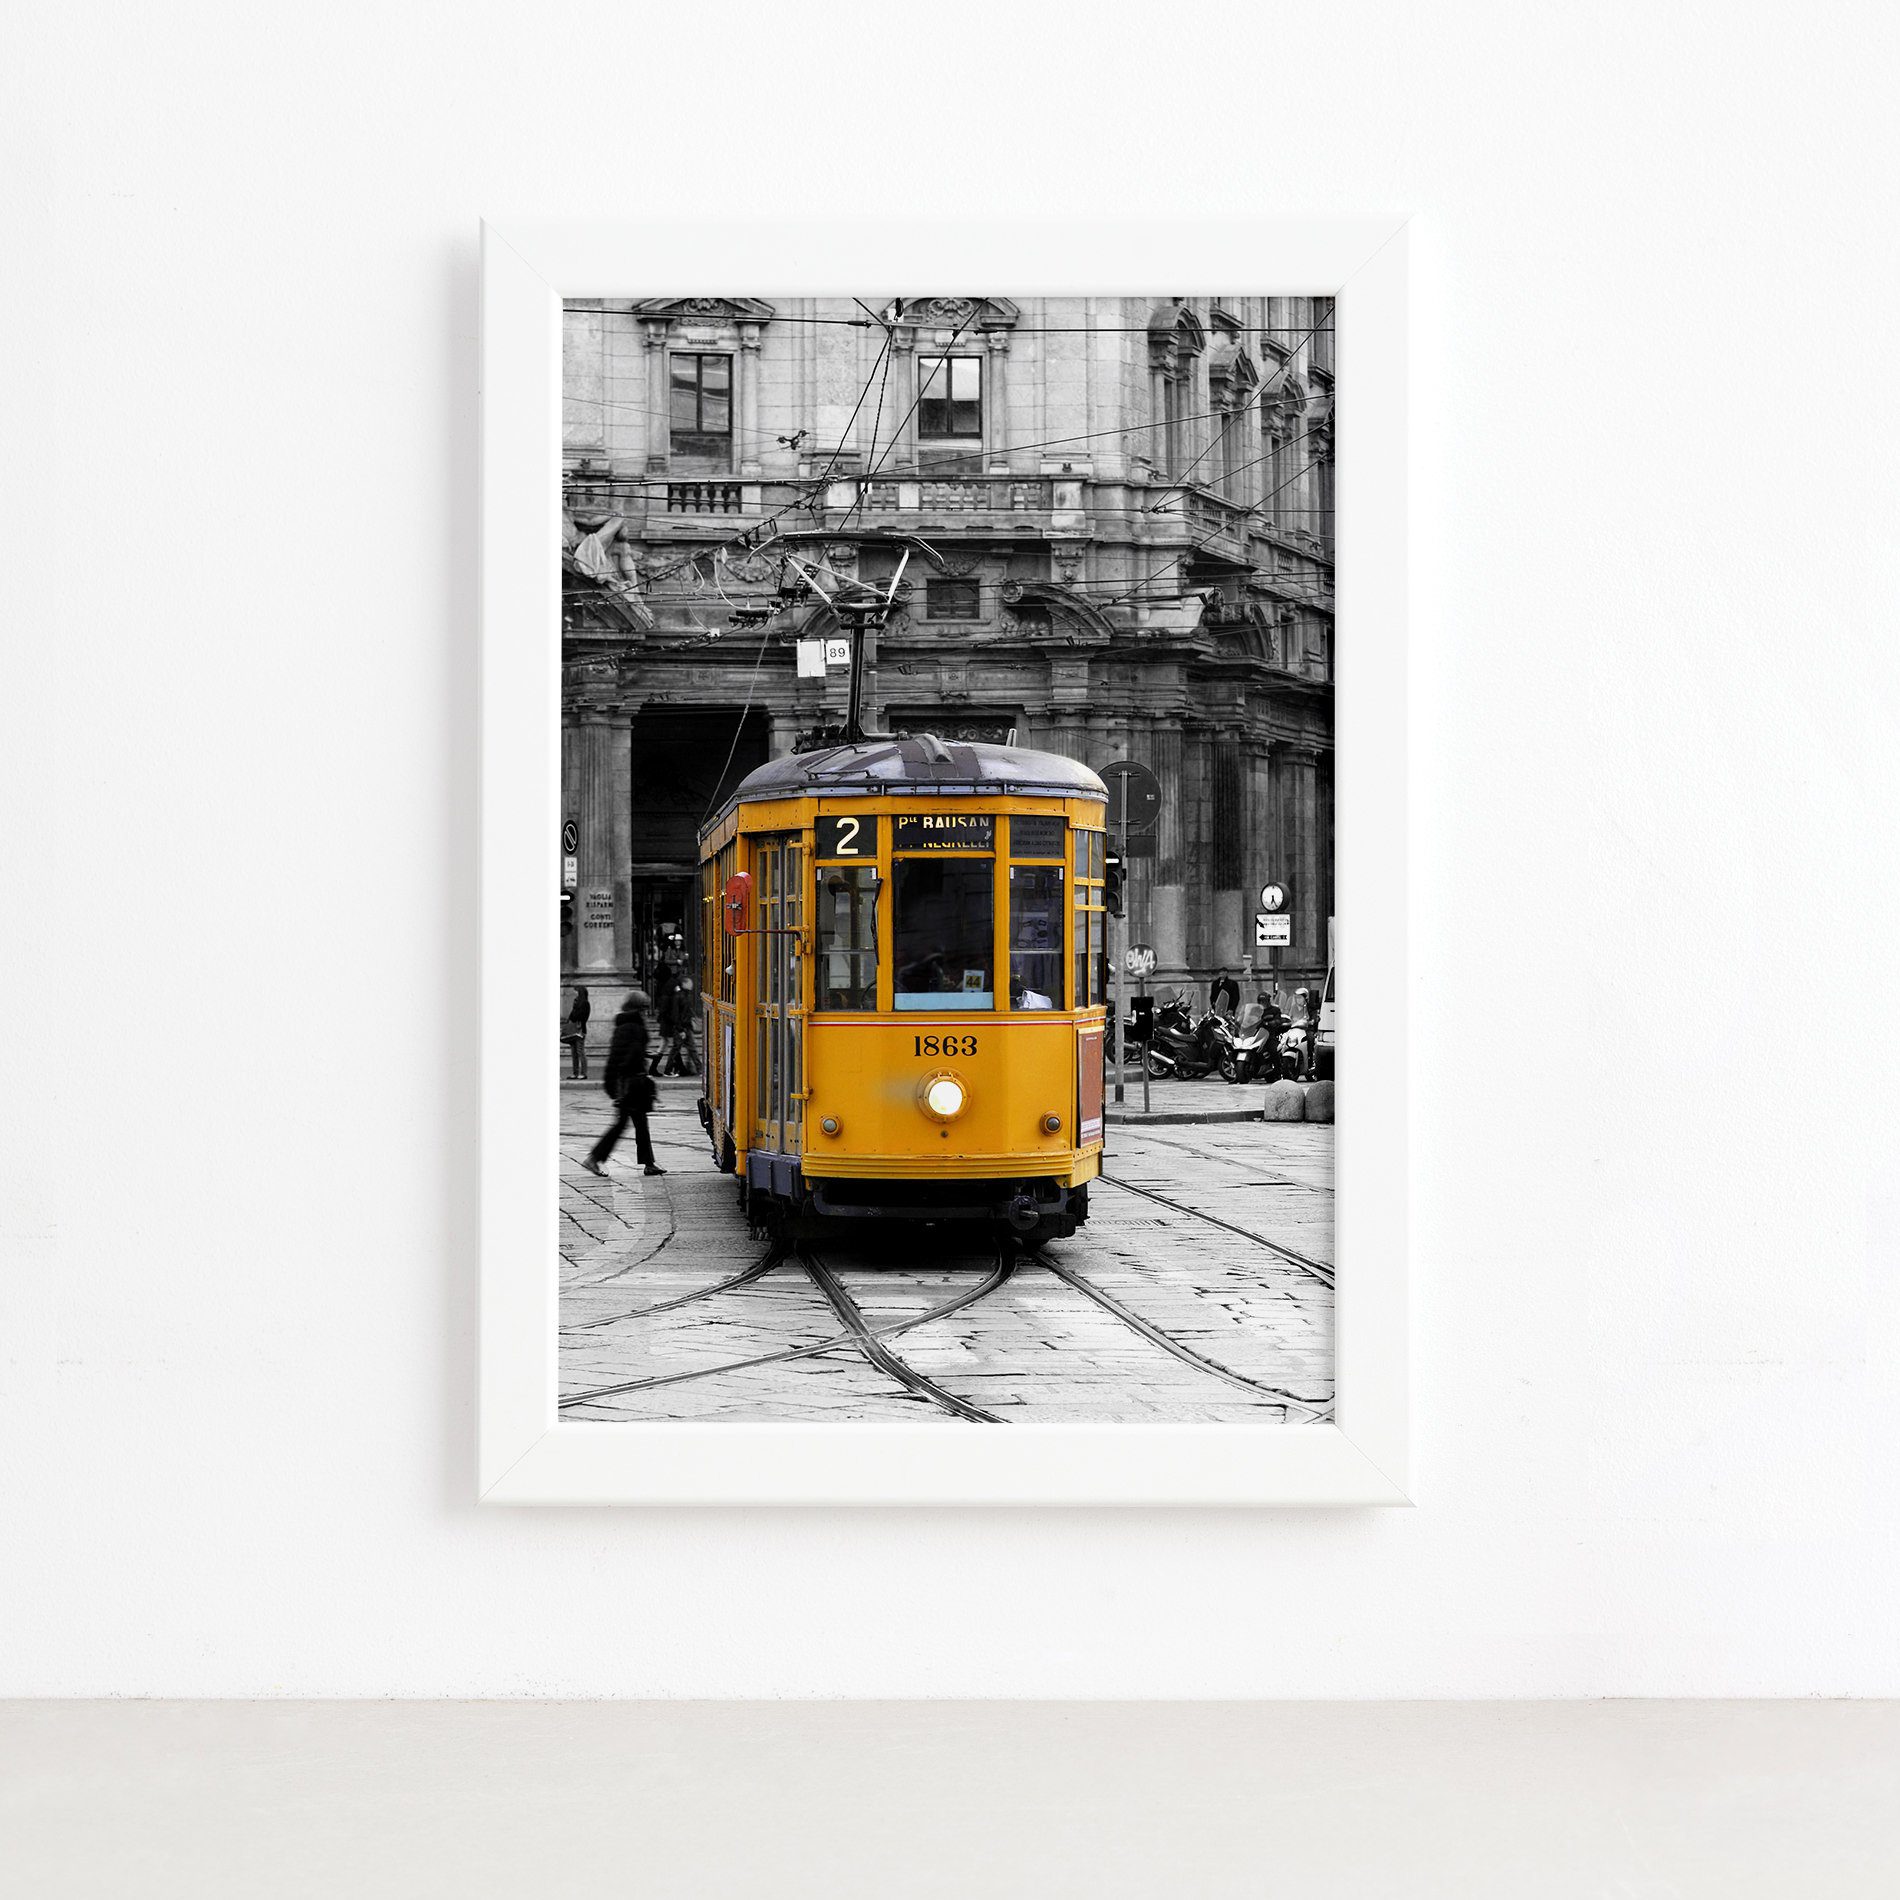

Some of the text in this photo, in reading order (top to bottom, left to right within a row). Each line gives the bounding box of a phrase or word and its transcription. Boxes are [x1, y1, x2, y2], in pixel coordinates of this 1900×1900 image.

[829, 647, 846, 658] 89
[836, 817, 860, 855] 2
[913, 1035, 979, 1057] 1863
